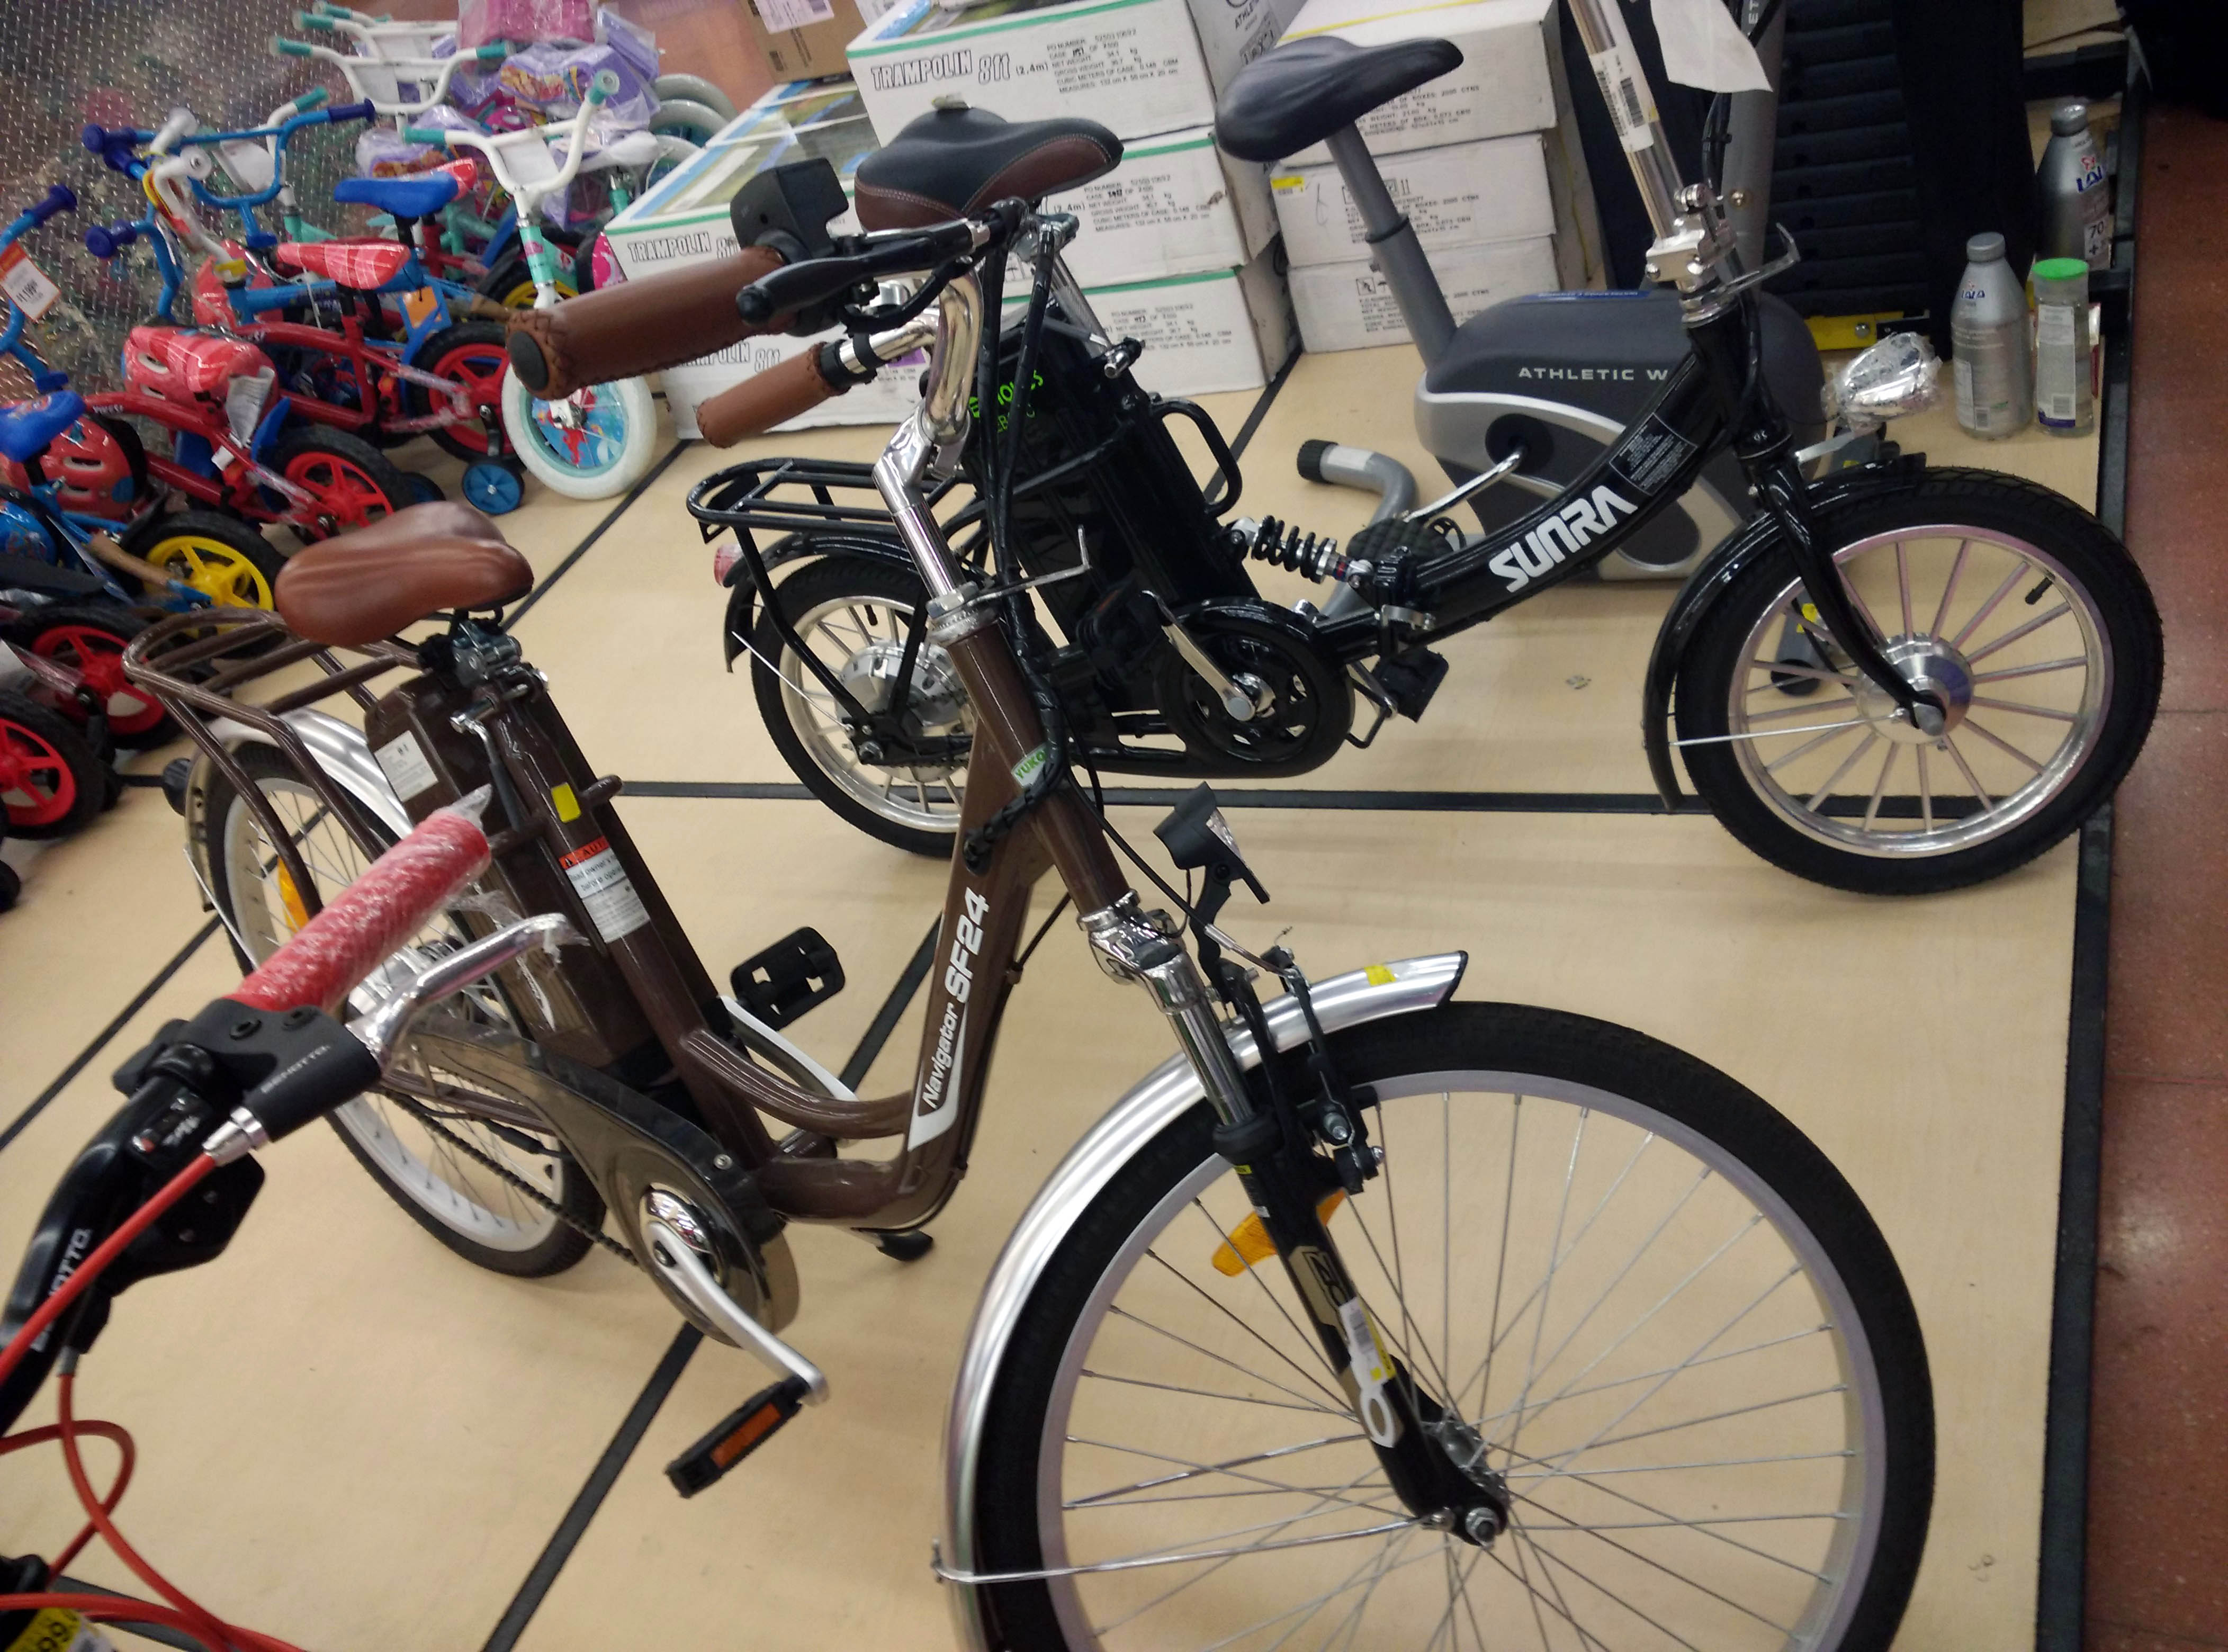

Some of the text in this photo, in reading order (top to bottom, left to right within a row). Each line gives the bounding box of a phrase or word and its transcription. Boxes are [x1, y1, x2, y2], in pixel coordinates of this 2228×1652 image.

[870, 49, 973, 91] TRAMPOLIN
[627, 231, 712, 263] TRAMPOLIN
[1519, 367, 1634, 380] ATHLETIC
[1488, 485, 1638, 593] SUNRA
[945, 886, 990, 1004] SF24
[922, 1001, 959, 1110] Navigator
